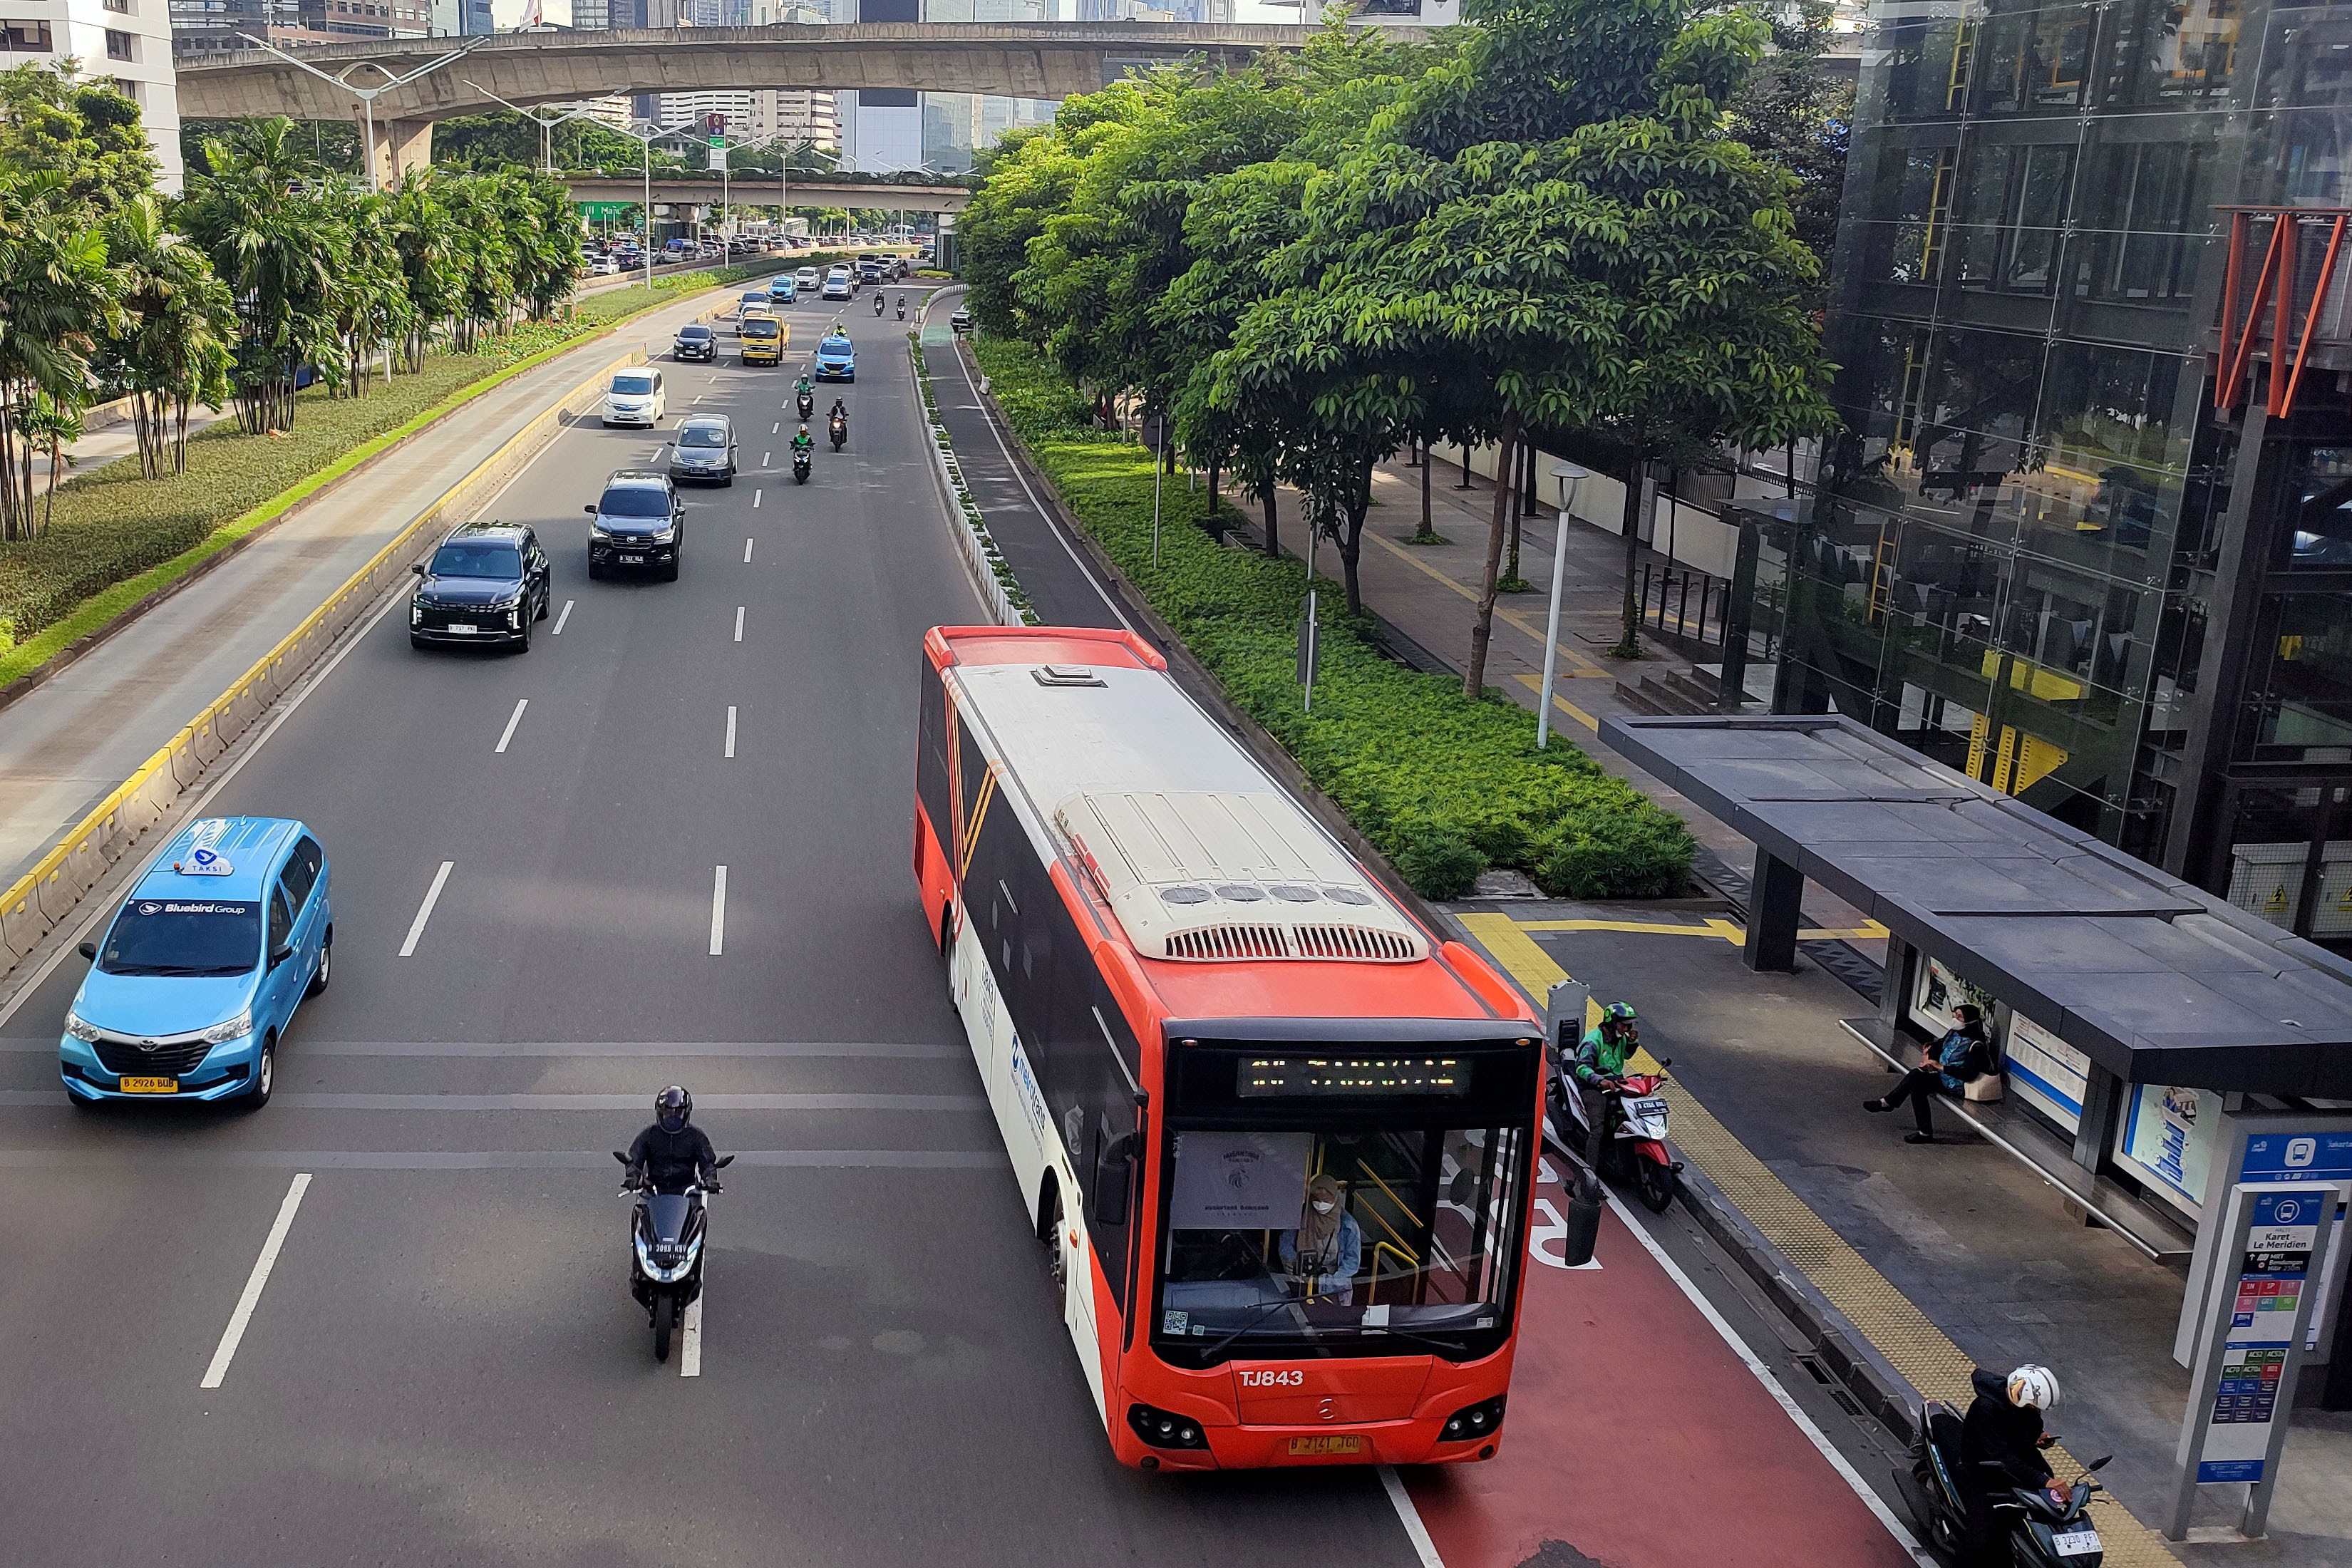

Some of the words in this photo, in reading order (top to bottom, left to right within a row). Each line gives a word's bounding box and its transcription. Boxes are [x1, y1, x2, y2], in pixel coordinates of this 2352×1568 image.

[165, 903, 215, 912] Bluebird
[215, 905, 245, 914] Group
[124, 1078, 130, 1088] B
[133, 1078, 155, 1088] 2926
[1018, 1058, 1046, 1130] metrotrans
[2265, 1232, 2290, 1241] Karet
[2266, 1240, 2306, 1249] Meridien
[1239, 1370, 1304, 1386] TJ843
[1291, 1438, 1298, 1450] B
[2054, 1537, 2061, 1546] B
